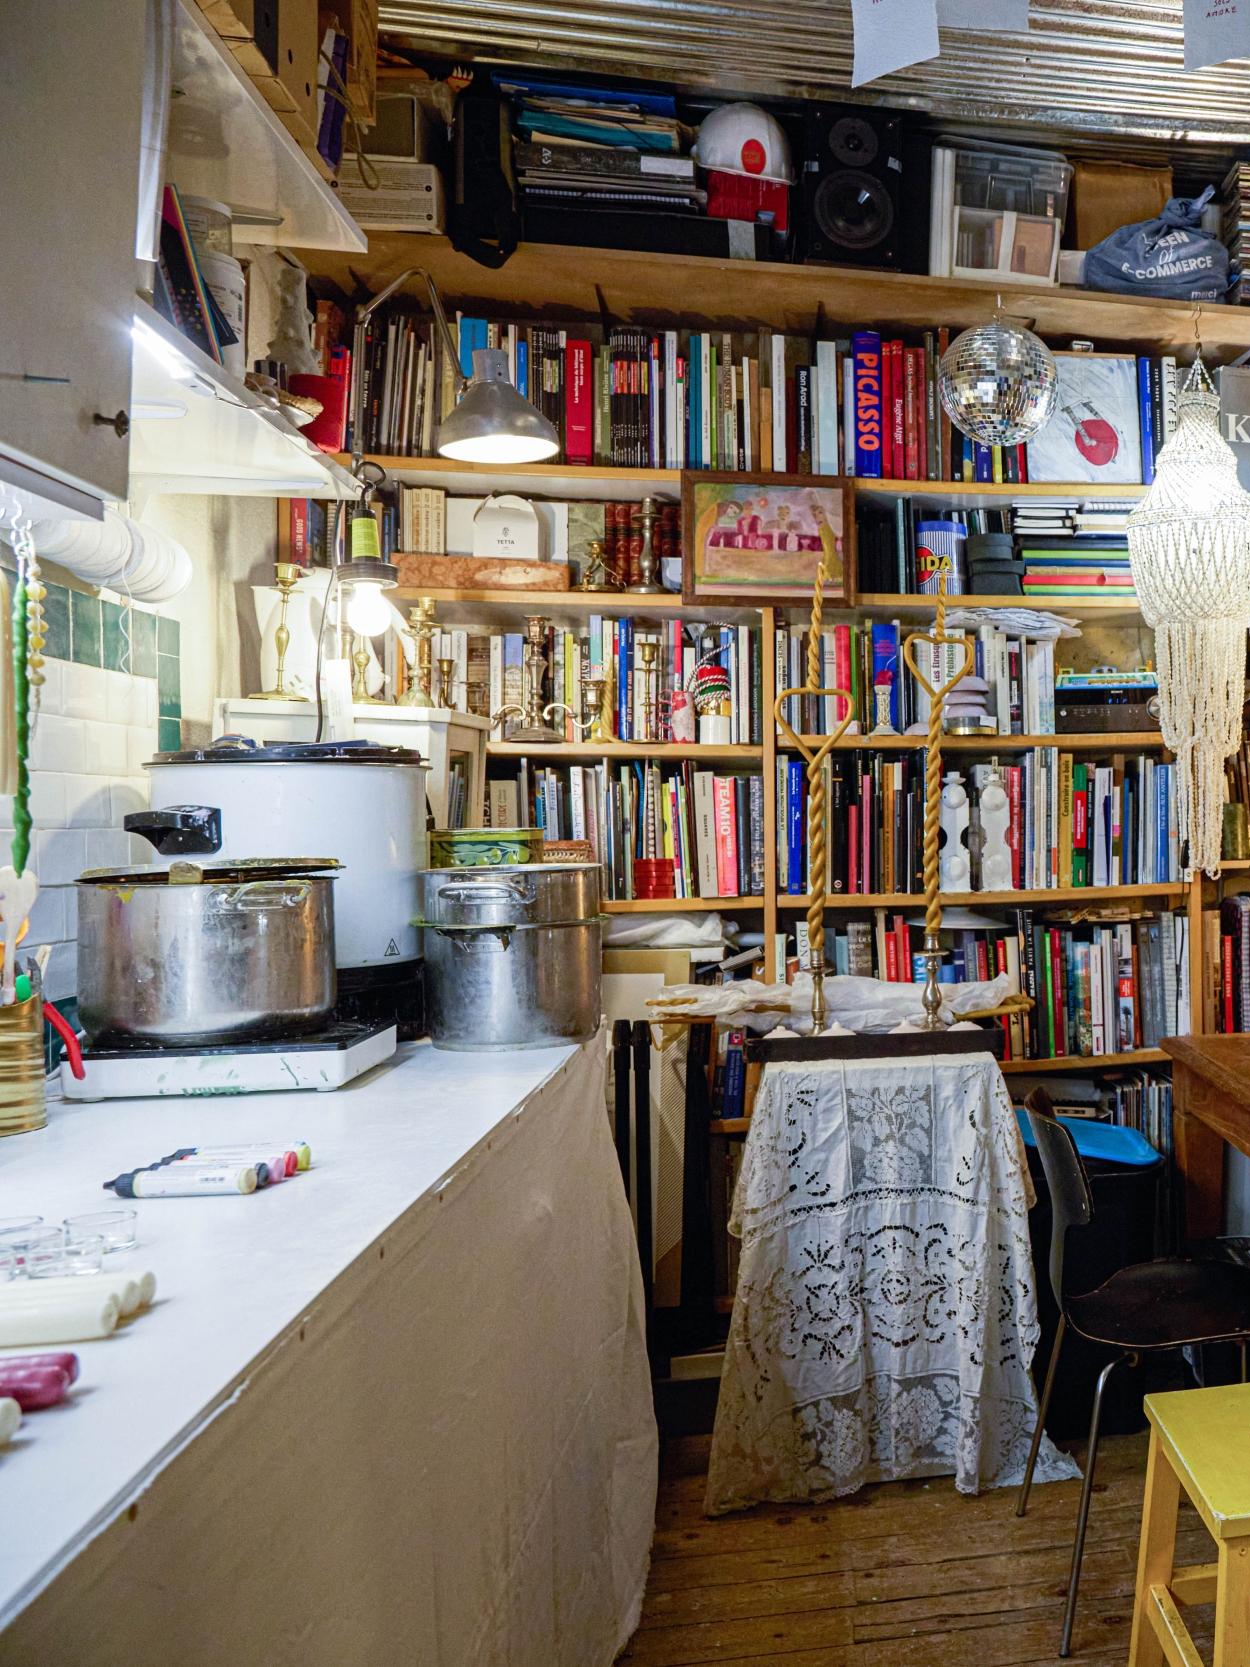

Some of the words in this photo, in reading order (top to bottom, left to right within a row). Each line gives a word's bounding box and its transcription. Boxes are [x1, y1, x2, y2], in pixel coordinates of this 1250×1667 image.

[1121, 255, 1213, 279] E-COMMERCE
[1191, 288, 1217, 298] merci
[799, 370, 807, 386] Ron
[799, 387, 807, 406] Arad
[856, 352, 880, 451] PICASSO
[894, 399, 904, 425] Eugène
[894, 426, 904, 444] Atget
[932, 670, 940, 683] Les
[1064, 774, 1069, 782] en
[1062, 784, 1070, 817] Construire
[1027, 937, 1033, 945] LA
